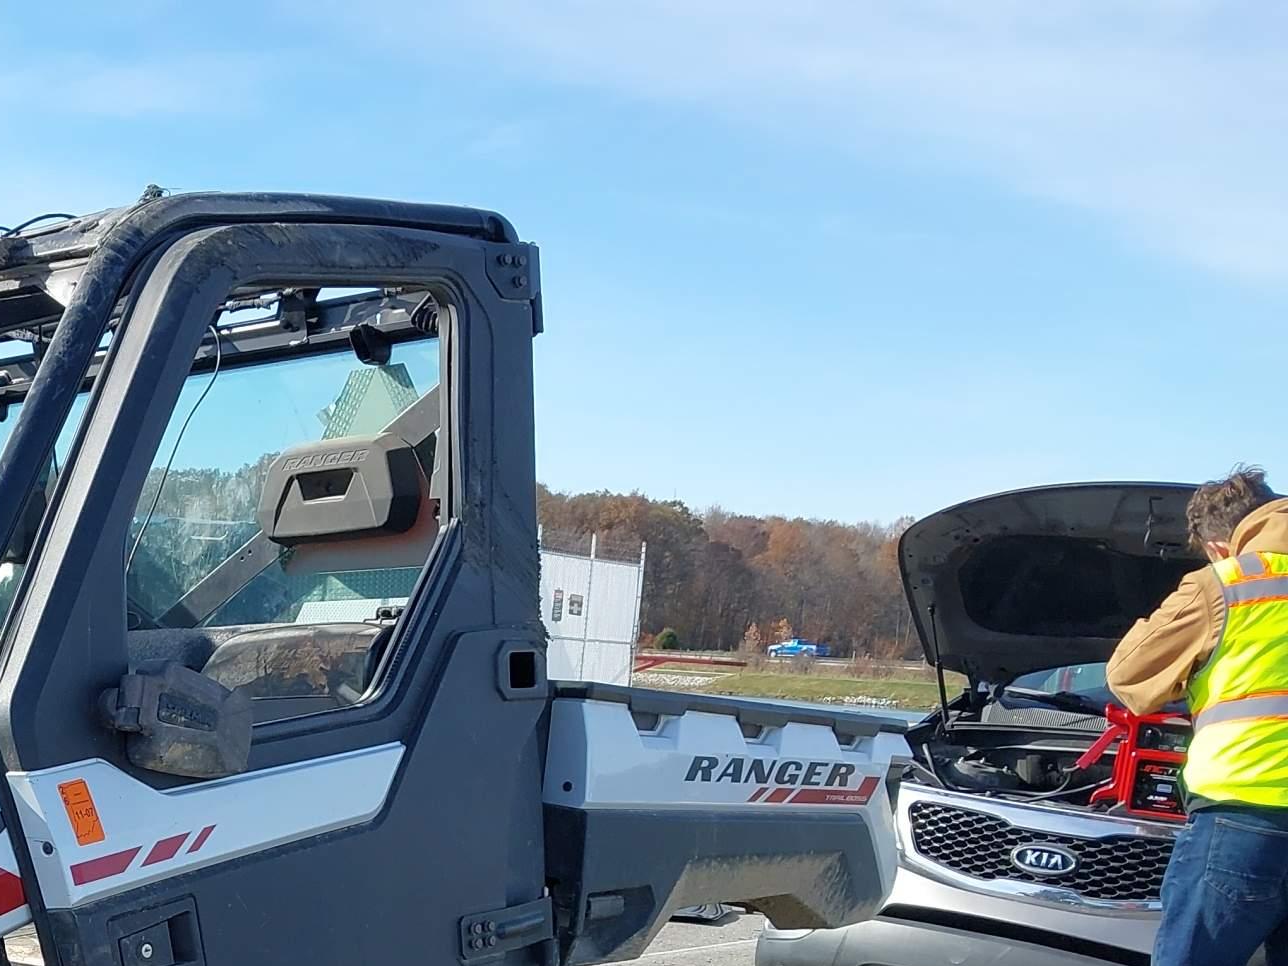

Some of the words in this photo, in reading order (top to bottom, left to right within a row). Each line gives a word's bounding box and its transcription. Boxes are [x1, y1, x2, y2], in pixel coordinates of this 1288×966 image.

[282, 448, 370, 472] RANGER
[684, 755, 856, 787] RANGER
[1024, 849, 1064, 870] KIA
